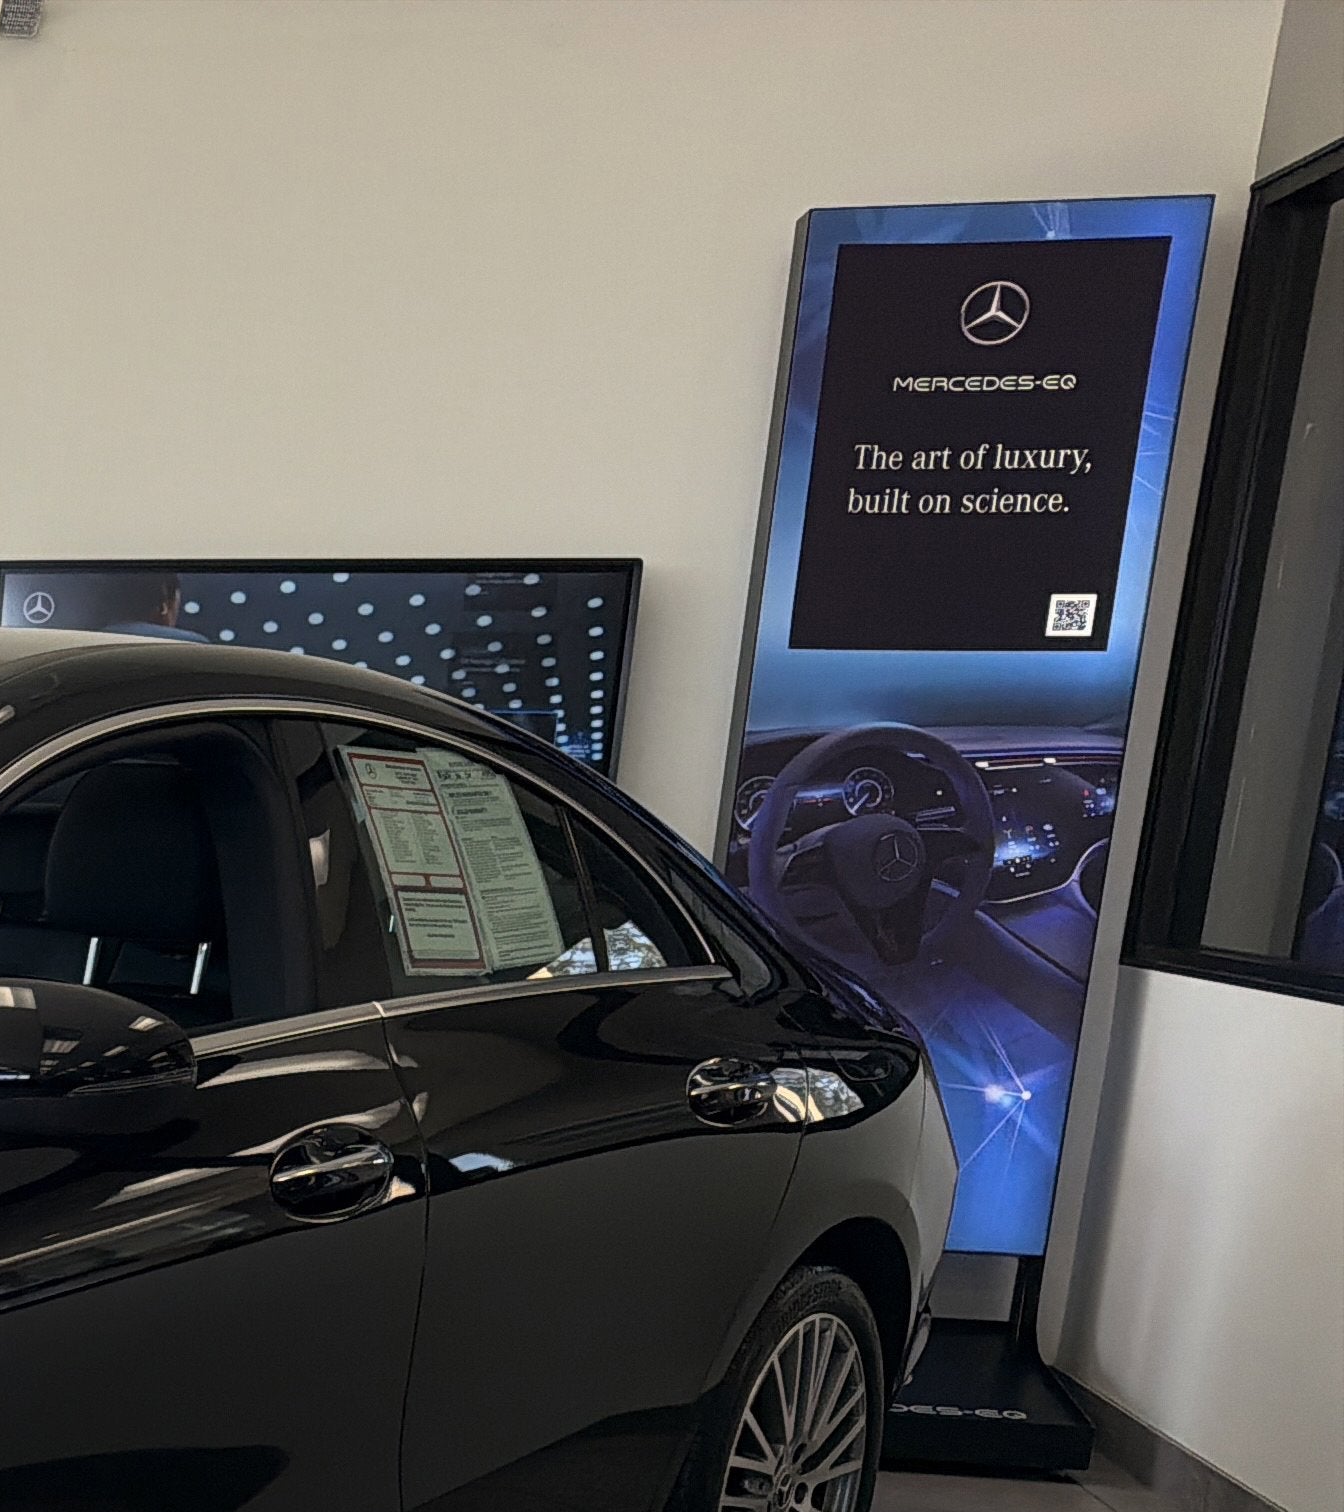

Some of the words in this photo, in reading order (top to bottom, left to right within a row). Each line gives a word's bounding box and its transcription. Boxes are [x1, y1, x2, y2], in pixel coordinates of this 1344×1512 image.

[892, 373, 1078, 393] MERCEDES-EQ
[854, 443, 903, 471] The
[910, 446, 951, 471] art
[959, 442, 989, 470] of
[993, 442, 1093, 474] luxury,
[847, 487, 911, 515] built
[918, 494, 952, 514] on
[960, 488, 1071, 514] science.
[887, 1402, 1028, 1420] DES-EQ
